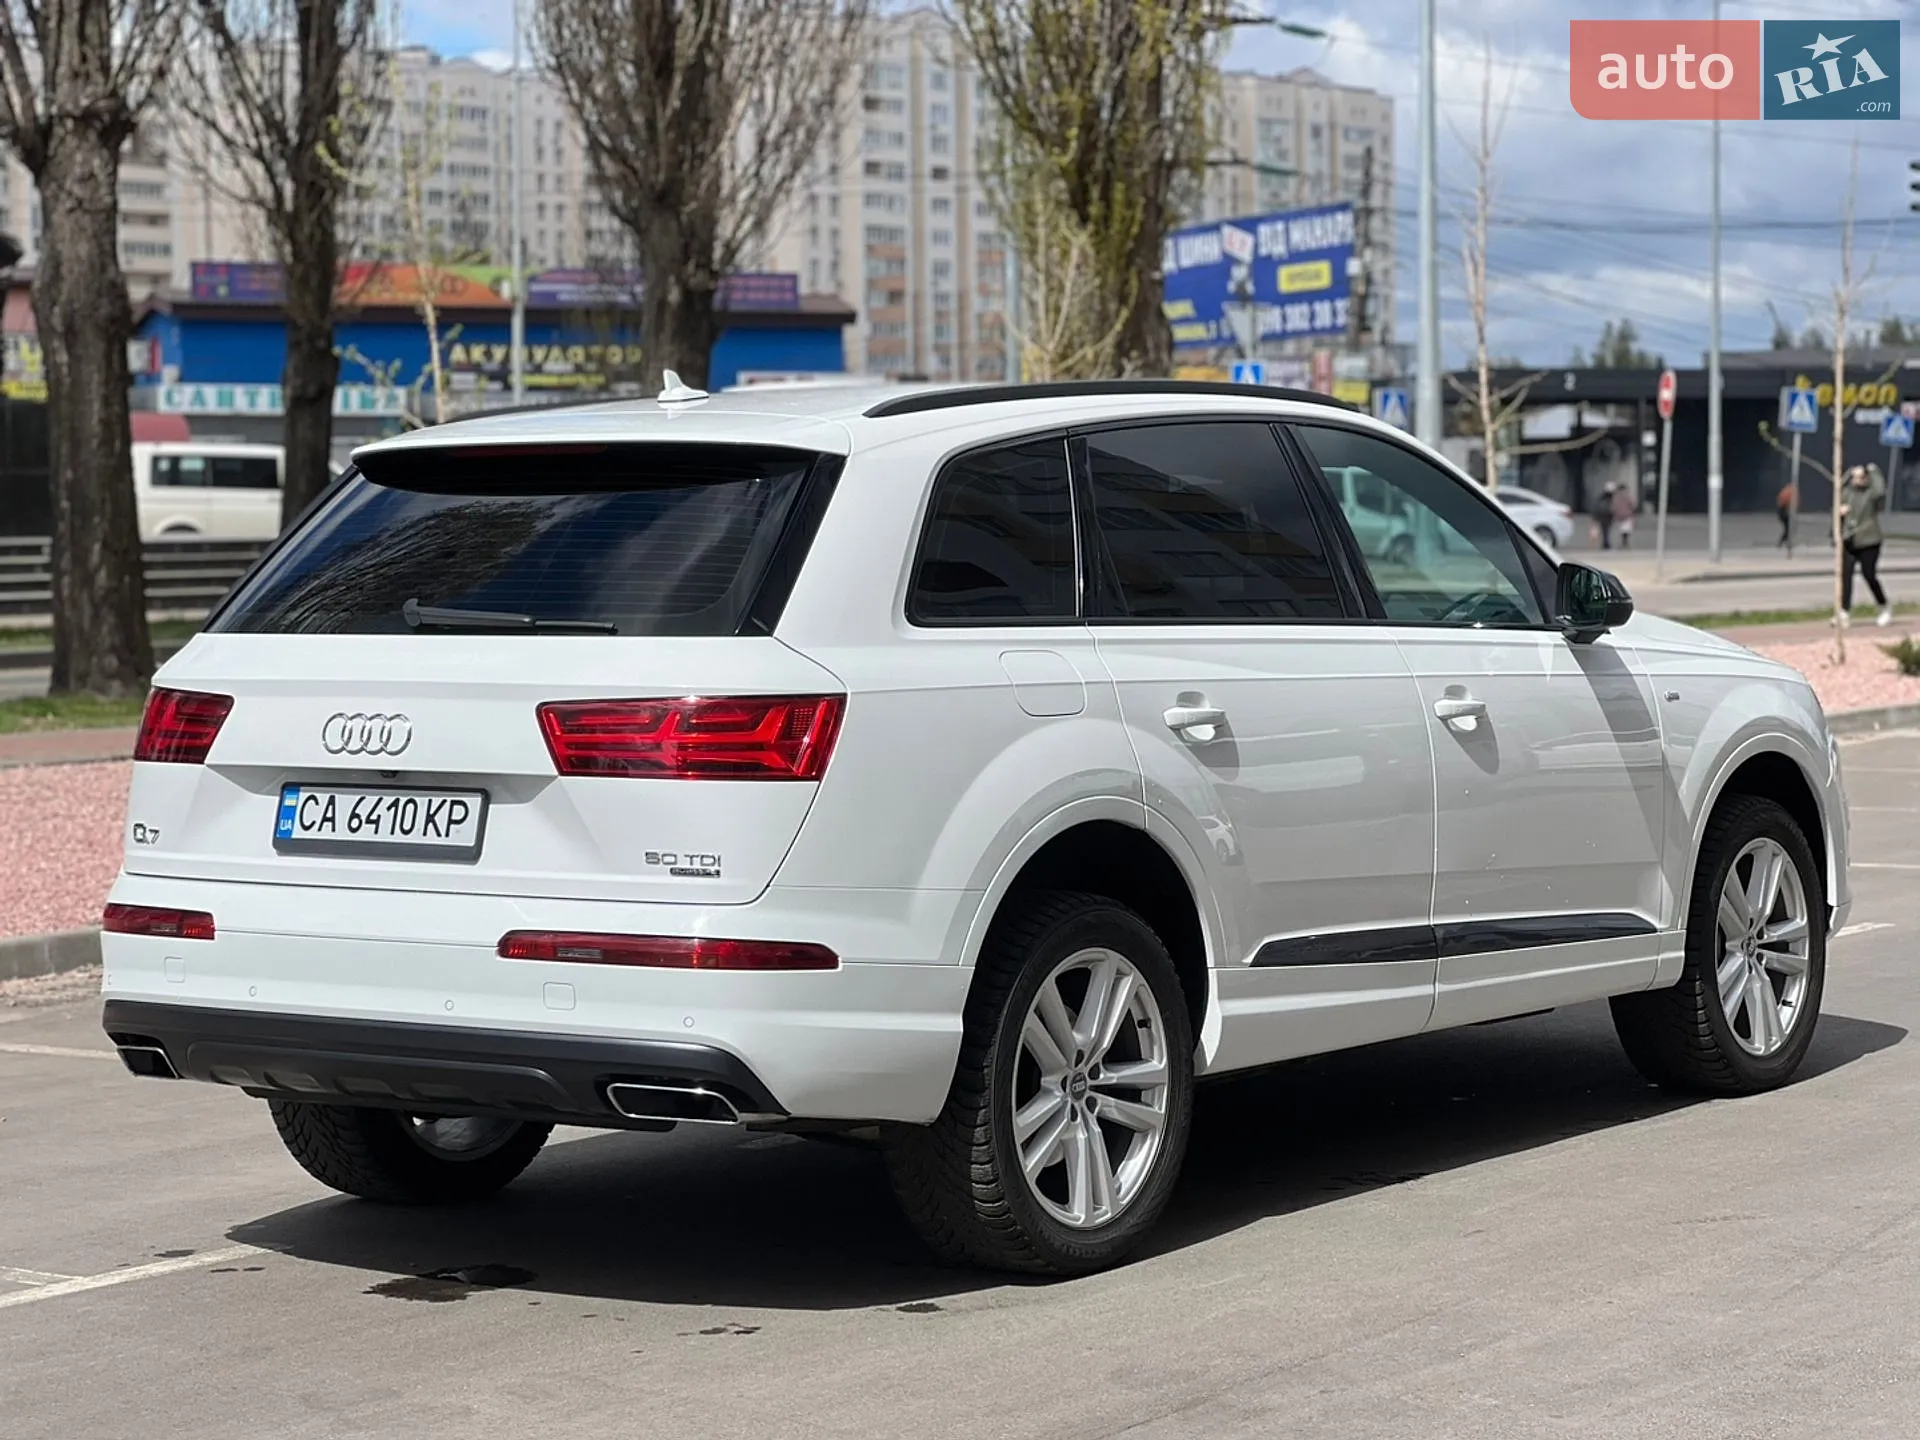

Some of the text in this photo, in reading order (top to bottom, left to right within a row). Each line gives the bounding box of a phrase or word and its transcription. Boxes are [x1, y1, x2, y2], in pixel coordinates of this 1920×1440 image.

[279, 818, 293, 831] UA
[299, 794, 469, 838] CA 6410 KP
[133, 822, 160, 845] Q7
[645, 851, 721, 868] 50 TDI
